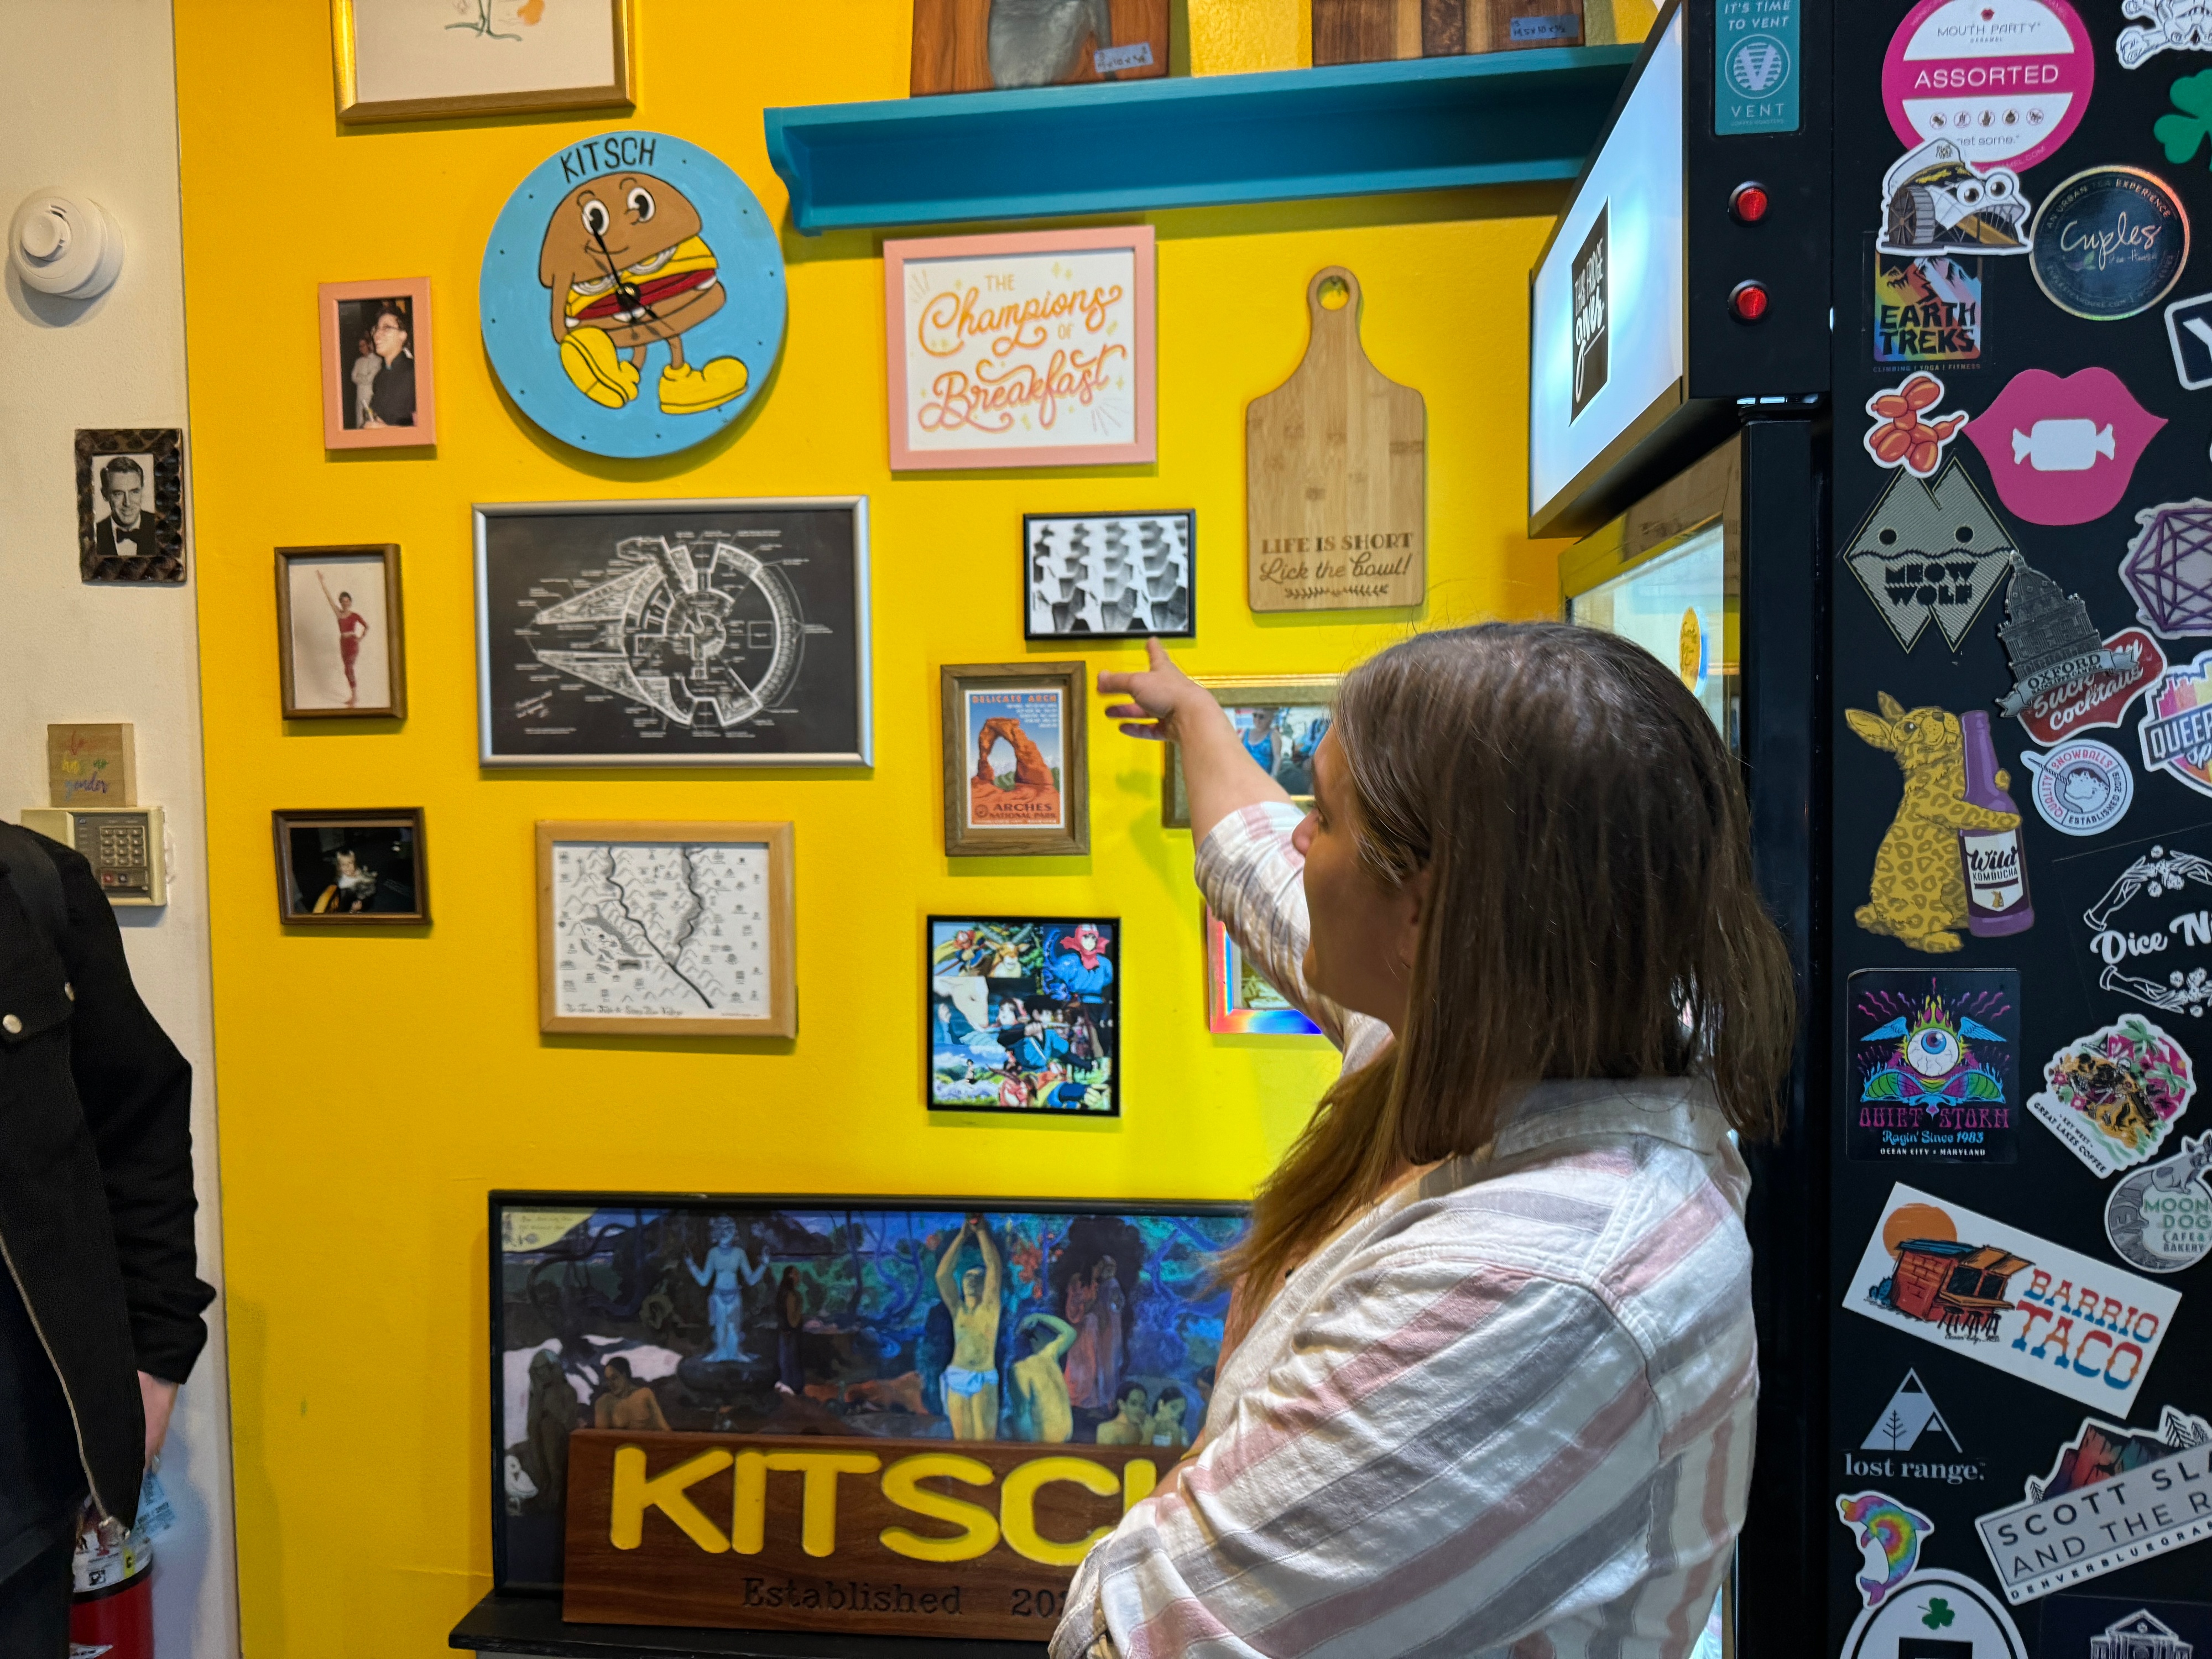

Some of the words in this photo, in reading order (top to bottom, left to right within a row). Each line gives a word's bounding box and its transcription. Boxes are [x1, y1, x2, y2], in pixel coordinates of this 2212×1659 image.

[1725, 3, 1750, 14] IT'S
[1756, 1, 1791, 12] TIME
[1729, 19, 1745, 30] TO
[1752, 16, 1790, 28] VENT
[1938, 23, 1985, 37] MOUTH
[1914, 64, 2059, 88] ASSORTED
[1731, 103, 1784, 117] VENT
[560, 137, 657, 183] KITSCH
[2116, 179, 2172, 217] EXPERIENCE
[984, 274, 1015, 292] THE
[1574, 268, 1586, 317] THIS
[918, 284, 1123, 357] Champions
[1880, 301, 1976, 329] EARTH
[1879, 328, 1975, 356] TREKS
[918, 343, 1128, 434] Breakfast
[1261, 537, 1311, 554] LIFE
[1316, 536, 1336, 552] IS
[1341, 532, 1413, 551] SHORT
[1259, 557, 1310, 585] Lick
[1316, 561, 1348, 579] the
[1349, 551, 1413, 577] bowl!
[1885, 561, 1978, 583] MEOW
[1884, 583, 1973, 606] WOLF
[2027, 654, 2101, 690] OXFORD
[2052, 749, 2112, 770] SNOWBALLS
[2042, 775, 2063, 817] QUALITY
[1968, 846, 2018, 872] Wild
[1973, 867, 2018, 881] KOMBUCHA
[2090, 930, 2168, 964] Dice
[2169, 910, 2212, 947] N
[1859, 1107, 1923, 1128] QUIET
[1939, 1107, 2009, 1129] STORM
[1882, 1130, 1919, 1146] Ragin'
[1921, 1130, 1954, 1143] Since
[1957, 1131, 1984, 1144] 1983
[2034, 1102, 2057, 1125] GREAT
[2056, 1123, 2079, 1146] LAKES
[2079, 1145, 2107, 1173] COFFEE
[2144, 1198, 2209, 1213] MOON
[2163, 1214, 2211, 1230] DOG
[2163, 1230, 2195, 1244] CAFE
[2163, 1243, 2204, 1252] BAKERY
[2023, 1268, 2159, 1344] BARRIO
[2011, 1300, 2143, 1390] TACO
[1844, 1453, 1895, 1477] lost
[1997, 1482, 2126, 1547] SCOTT
[2151, 1450, 2212, 1491] SL
[2013, 1536, 2085, 1579] AND
[2100, 1504, 2174, 1543] THE
[742, 1577, 963, 1616] Established
